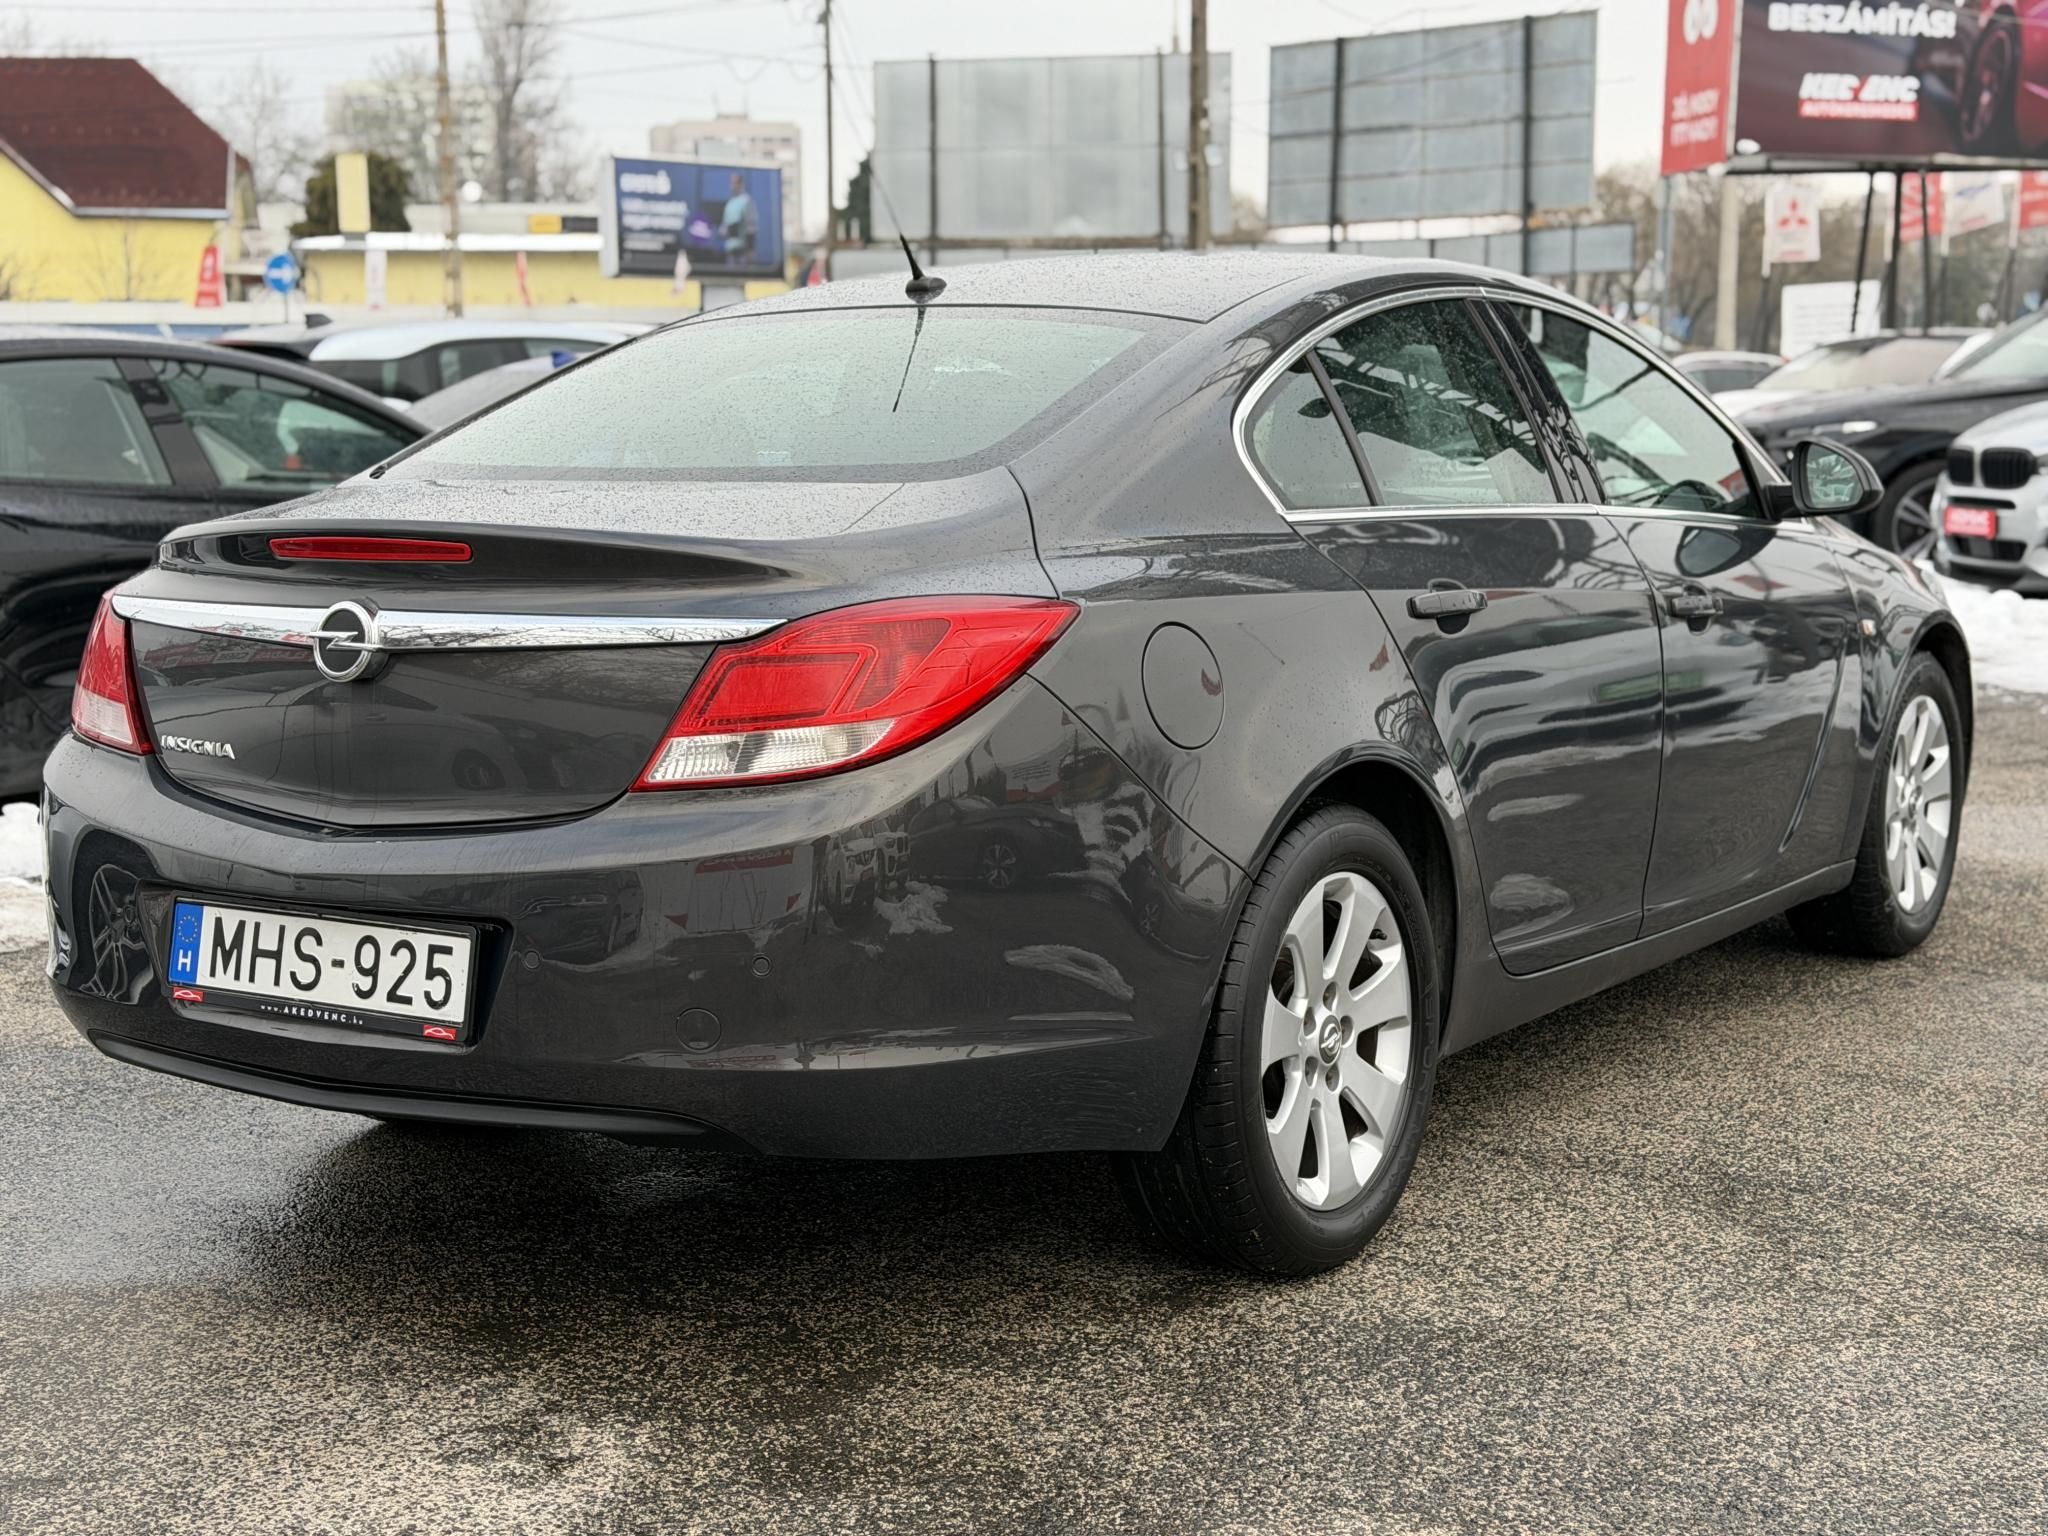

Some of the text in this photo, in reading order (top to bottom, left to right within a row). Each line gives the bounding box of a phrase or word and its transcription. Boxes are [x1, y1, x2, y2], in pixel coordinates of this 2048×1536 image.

[161, 735, 236, 760] INSIGNIA
[177, 948, 192, 972] H
[208, 916, 454, 1012] MHS-925
